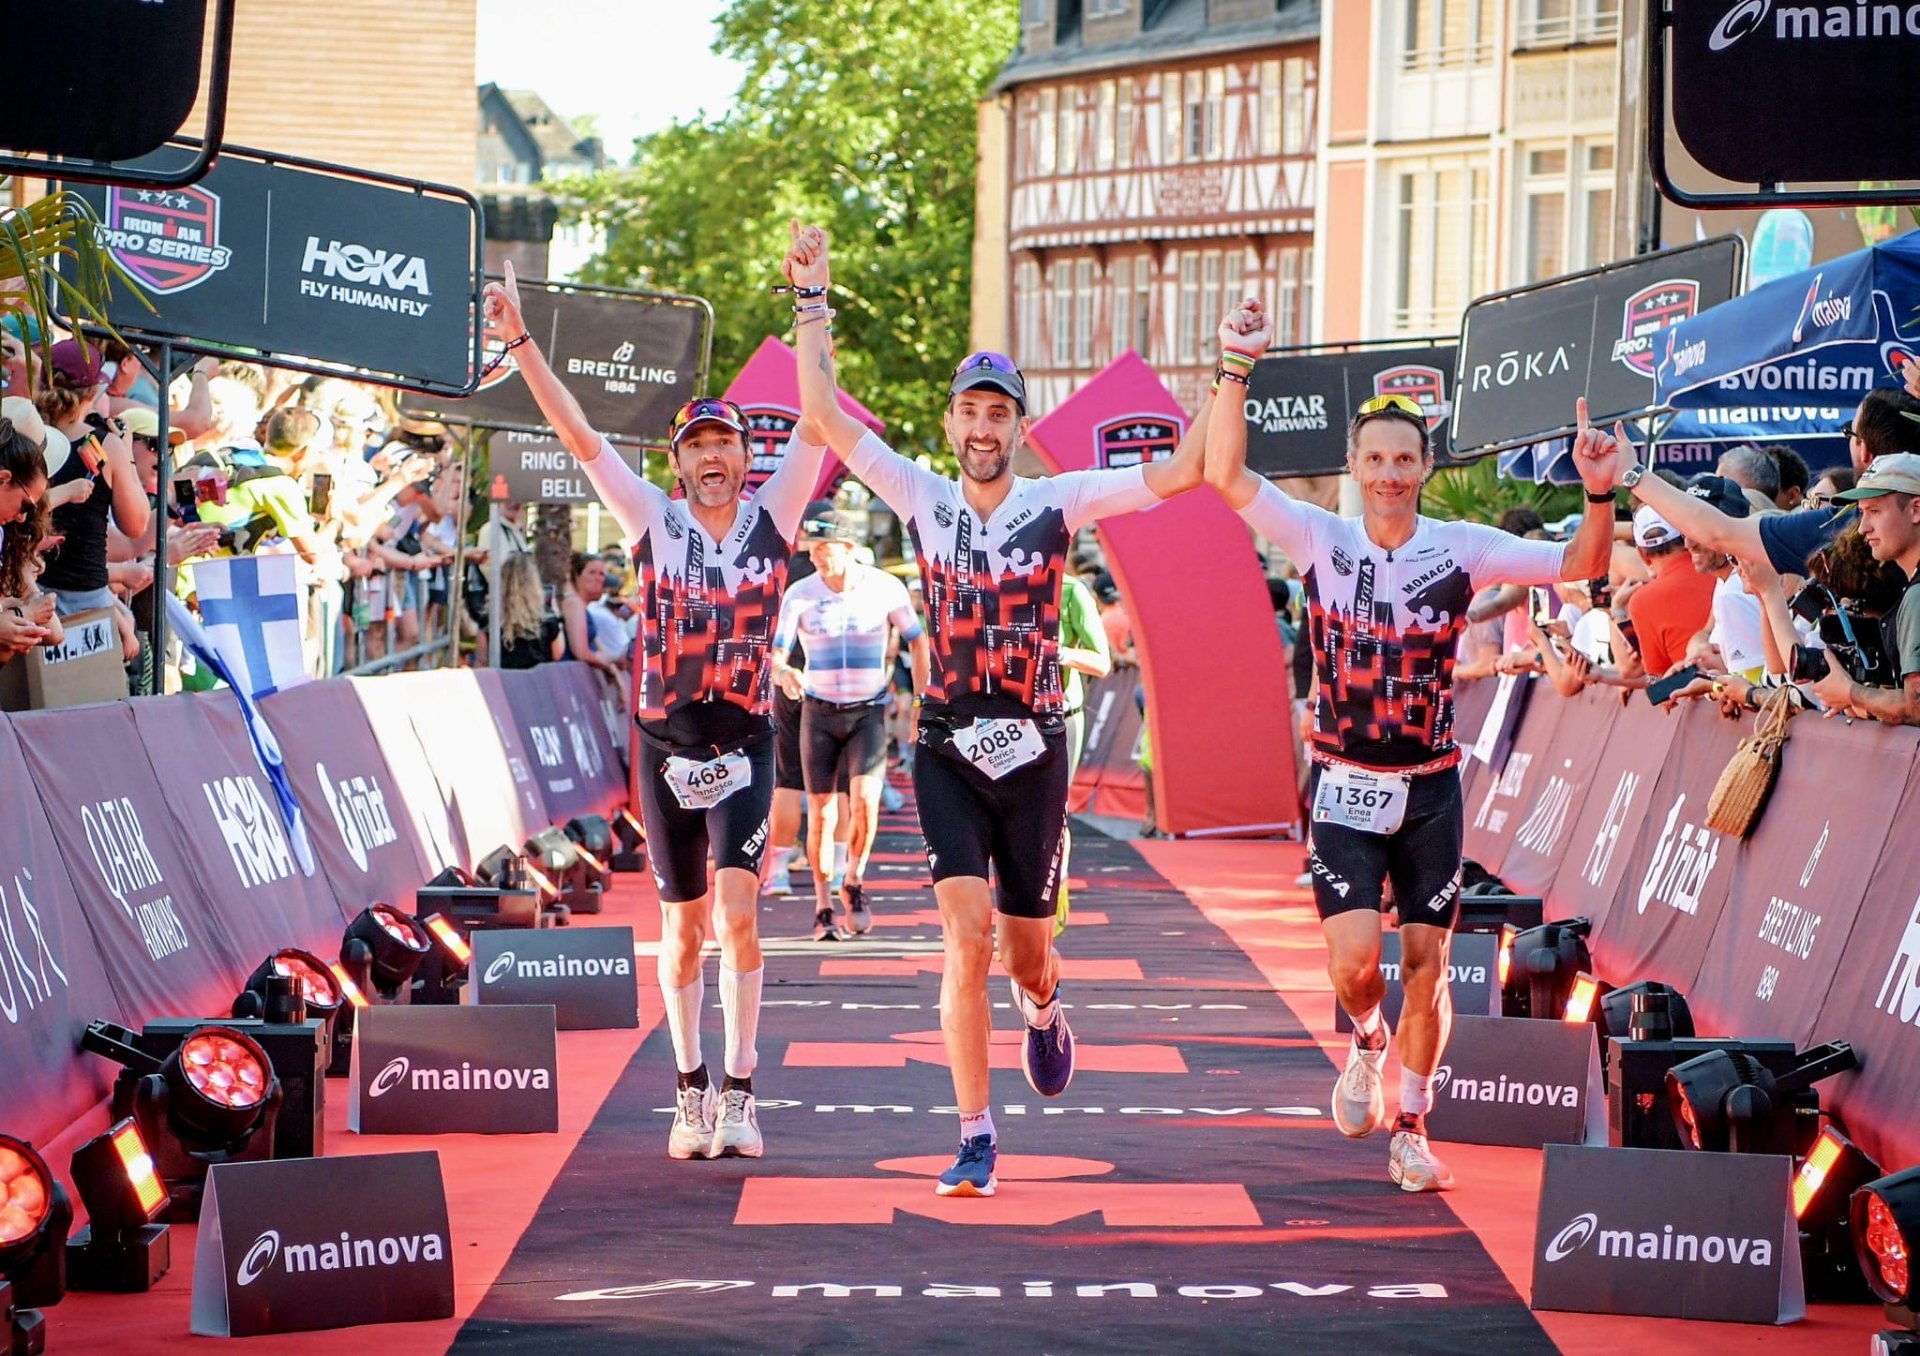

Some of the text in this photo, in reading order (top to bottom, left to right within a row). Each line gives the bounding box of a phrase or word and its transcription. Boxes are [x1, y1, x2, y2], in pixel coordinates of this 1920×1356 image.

[97, 230, 226, 266] PRO SERIES
[301, 236, 430, 296] HOKA
[301, 279, 429, 317] FLY HUMAN FLY
[1616, 337, 1647, 356] PRO
[567, 358, 677, 384] BREITLING
[605, 380, 636, 394] 1884
[1244, 394, 1326, 422] QATAR
[1263, 416, 1328, 433] AIRWAYS
[521, 452, 566, 470] RING
[541, 478, 586, 497] BELL
[735, 515, 753, 542] IOZZI
[1005, 508, 1032, 531] NERI
[1401, 558, 1453, 594] MONACO
[967, 723, 1023, 763] 2088
[987, 748, 1015, 765] Enrico
[687, 763, 729, 788] 468
[1335, 786, 1393, 810] 1367
[1347, 807, 1372, 817] Enea
[202, 776, 295, 888] HOKA
[81, 797, 163, 919] QATAR
[135, 895, 188, 961] AIRWAYS
[1758, 896, 1821, 960] BREITLING
[517, 954, 630, 978] mainova
[1379, 963, 1486, 984] mova
[1755, 964, 1780, 1002] 1884
[411, 1062, 550, 1091] mainova
[1450, 1075, 1579, 1108] mainova
[284, 1231, 443, 1273] mainova
[1598, 1224, 1772, 1267] mainova
[771, 1280, 1450, 1300] mainova
